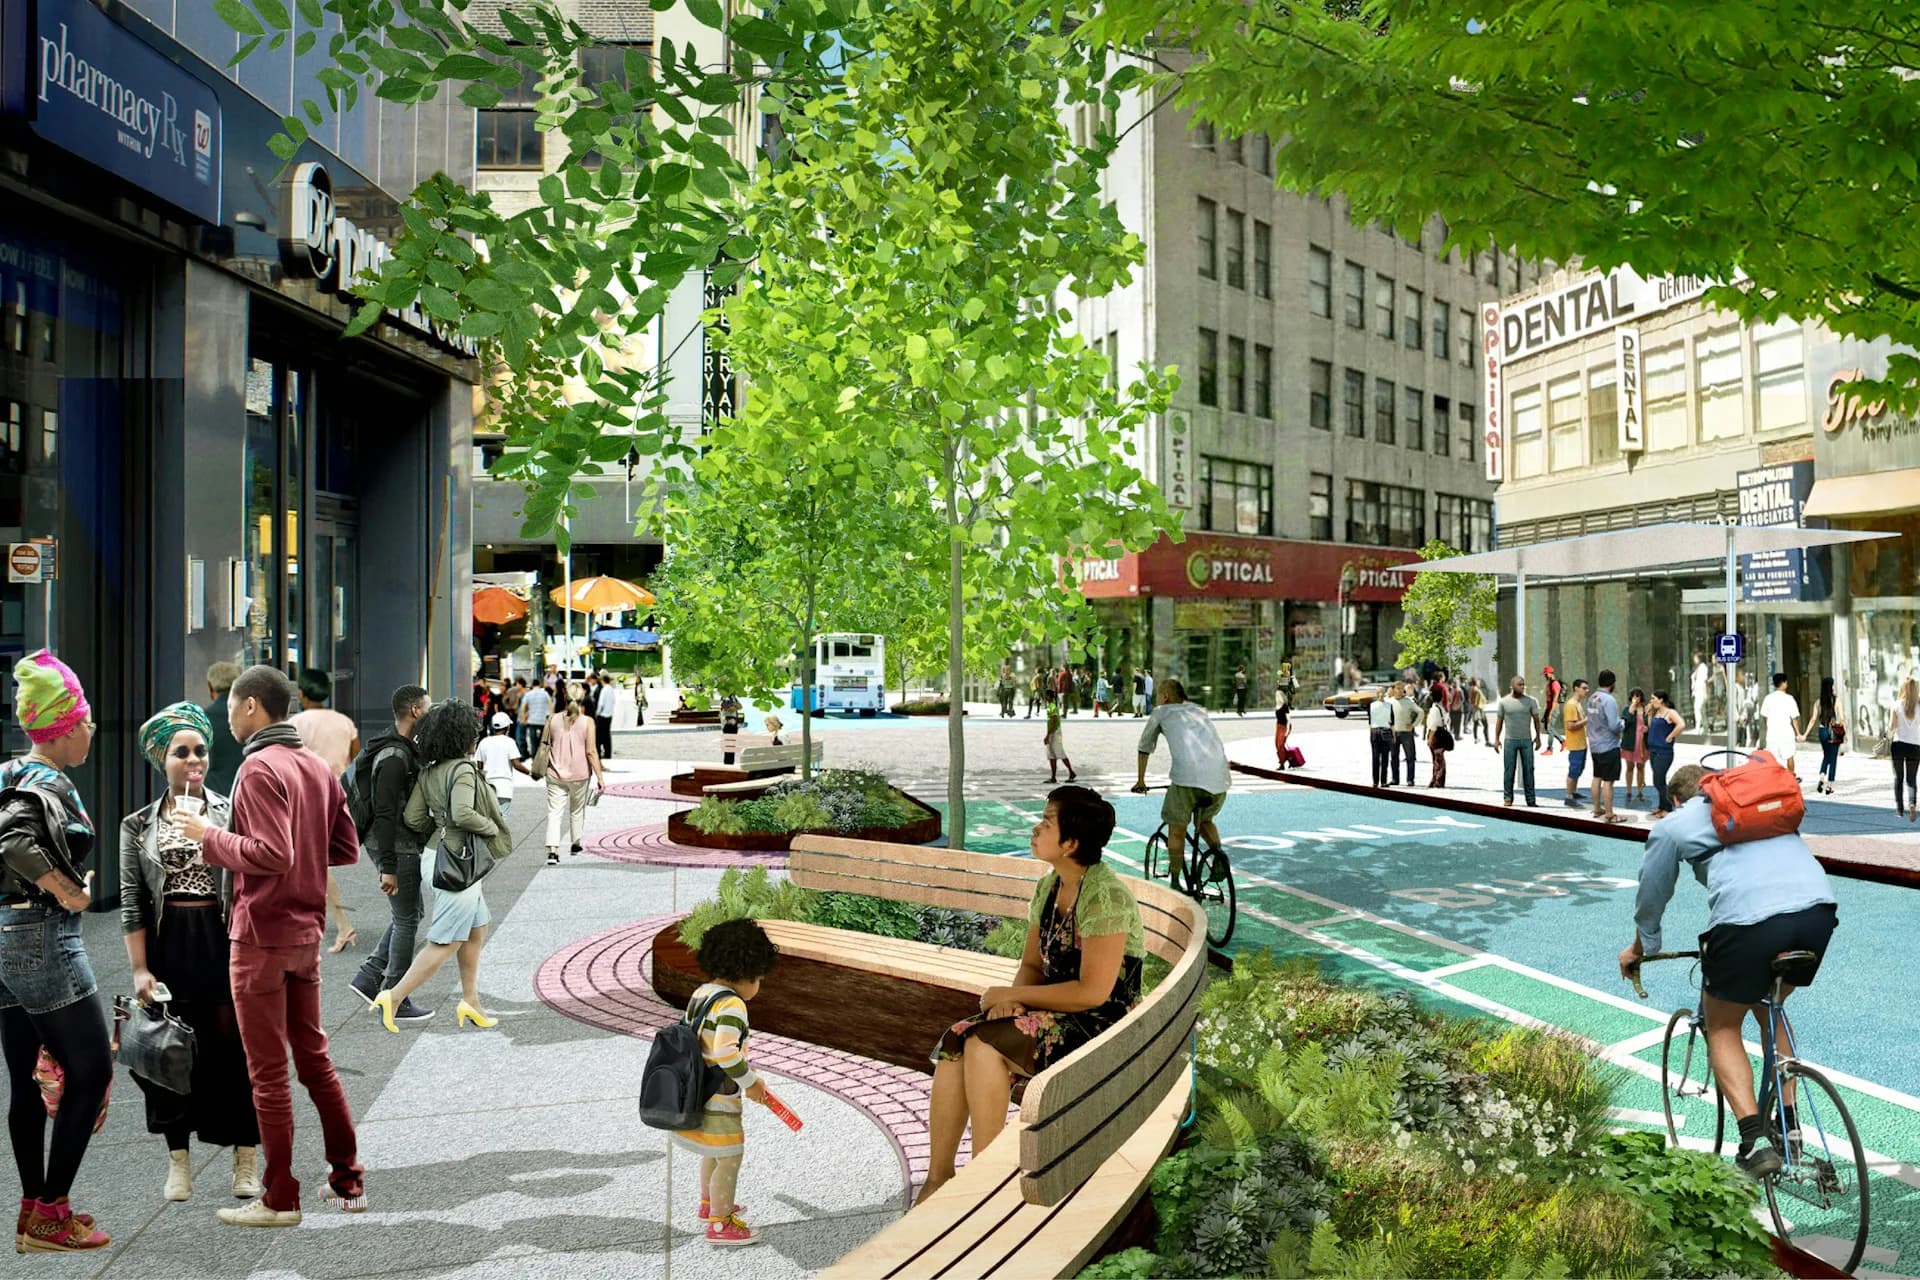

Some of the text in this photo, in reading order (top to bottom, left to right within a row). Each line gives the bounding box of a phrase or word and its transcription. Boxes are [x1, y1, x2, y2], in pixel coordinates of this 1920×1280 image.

[38, 22, 161, 159] pharmacy
[117, 129, 142, 154] WITHIN
[1503, 273, 1635, 357] DENTAL
[718, 347, 733, 429] RYAN
[1622, 335, 1639, 442] DENTAL
[1739, 481, 1794, 515] DENTAL
[1741, 507, 1795, 527] ASSOCIATES
[1222, 815, 1487, 850] ONLY
[1386, 871, 1640, 908] BUS
